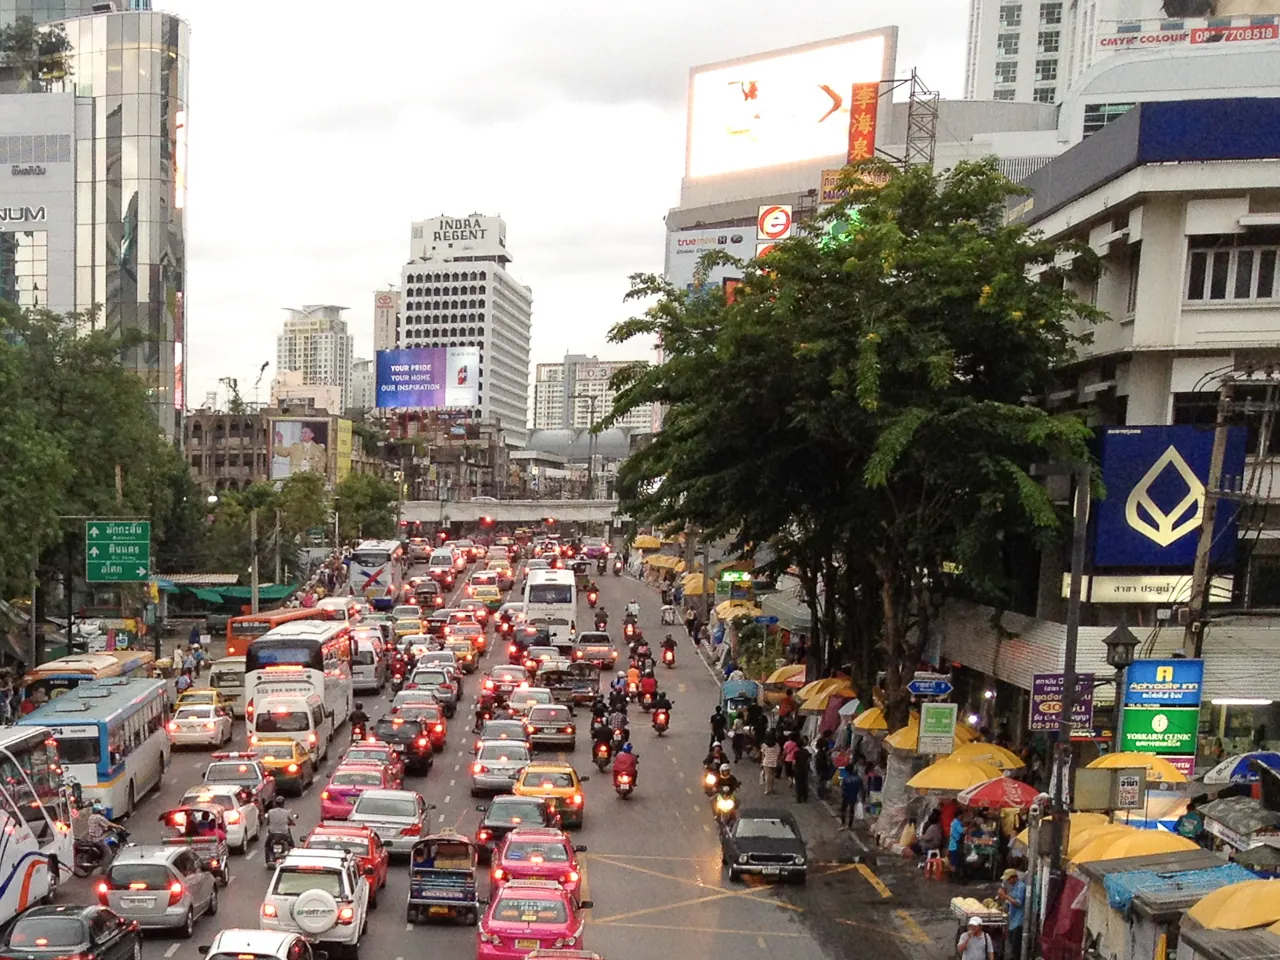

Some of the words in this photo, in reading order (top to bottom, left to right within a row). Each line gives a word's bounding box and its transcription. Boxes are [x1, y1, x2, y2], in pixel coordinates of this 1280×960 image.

[1100, 38, 1135, 46] CMYK
[1140, 34, 1186, 44] COLOUR
[849, 86, 876, 160] 李海泉
[440, 219, 482, 231] INDRA
[433, 229, 488, 241] REGENT
[391, 364, 410, 372] YOUR
[391, 374, 409, 382] YOUR
[397, 383, 440, 391] INSPIRATION
[106, 523, 142, 534] มักกะสัน
[108, 543, 139, 554] ดินแดง
[101, 561, 123, 573] อโศก
[1113, 584, 1137, 593] สาขา
[1140, 583, 1176, 594] ประตูน้ำ
[1129, 681, 1180, 690] Aphrodite
[1164, 733, 1192, 741] CLINIC
